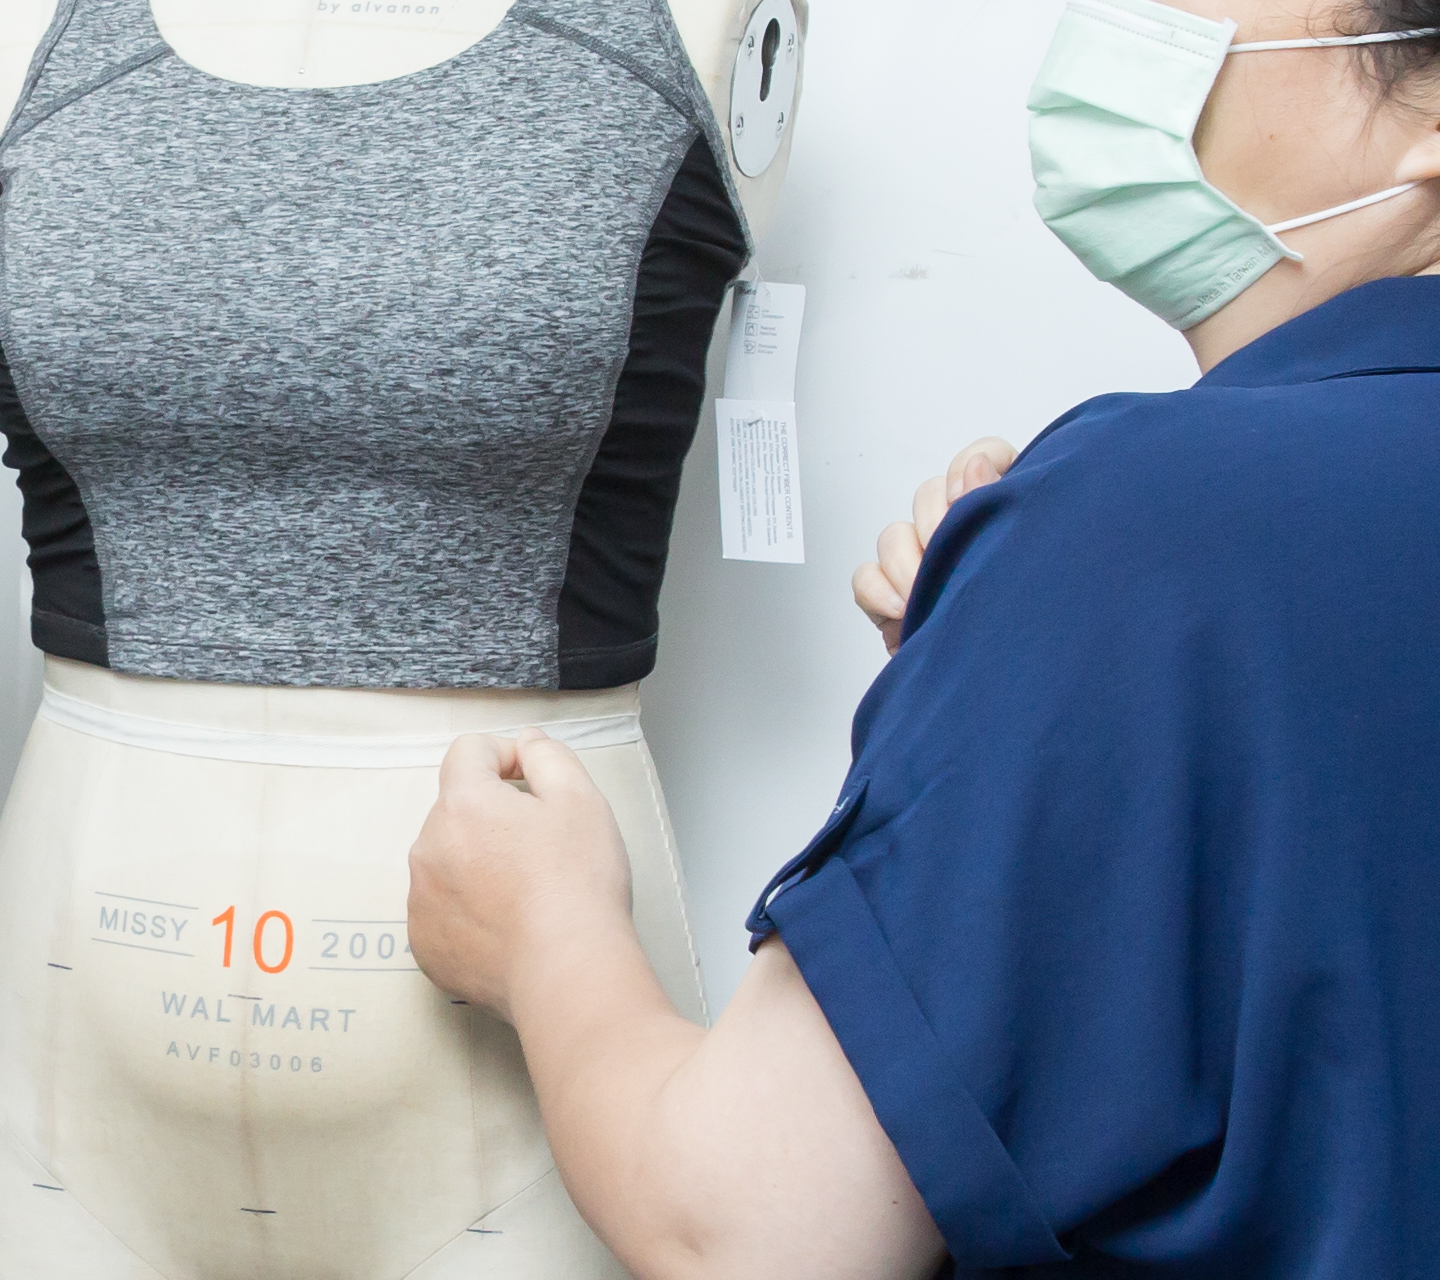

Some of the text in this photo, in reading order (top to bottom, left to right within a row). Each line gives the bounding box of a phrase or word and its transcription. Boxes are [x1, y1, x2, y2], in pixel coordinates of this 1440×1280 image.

[317, 0, 440, 15] by alvanon
[99, 906, 189, 942] MISSY
[211, 904, 294, 974] 10
[320, 931, 411, 960] 200
[161, 990, 357, 1033] WAL MART
[165, 1040, 323, 1073] AVF03006
